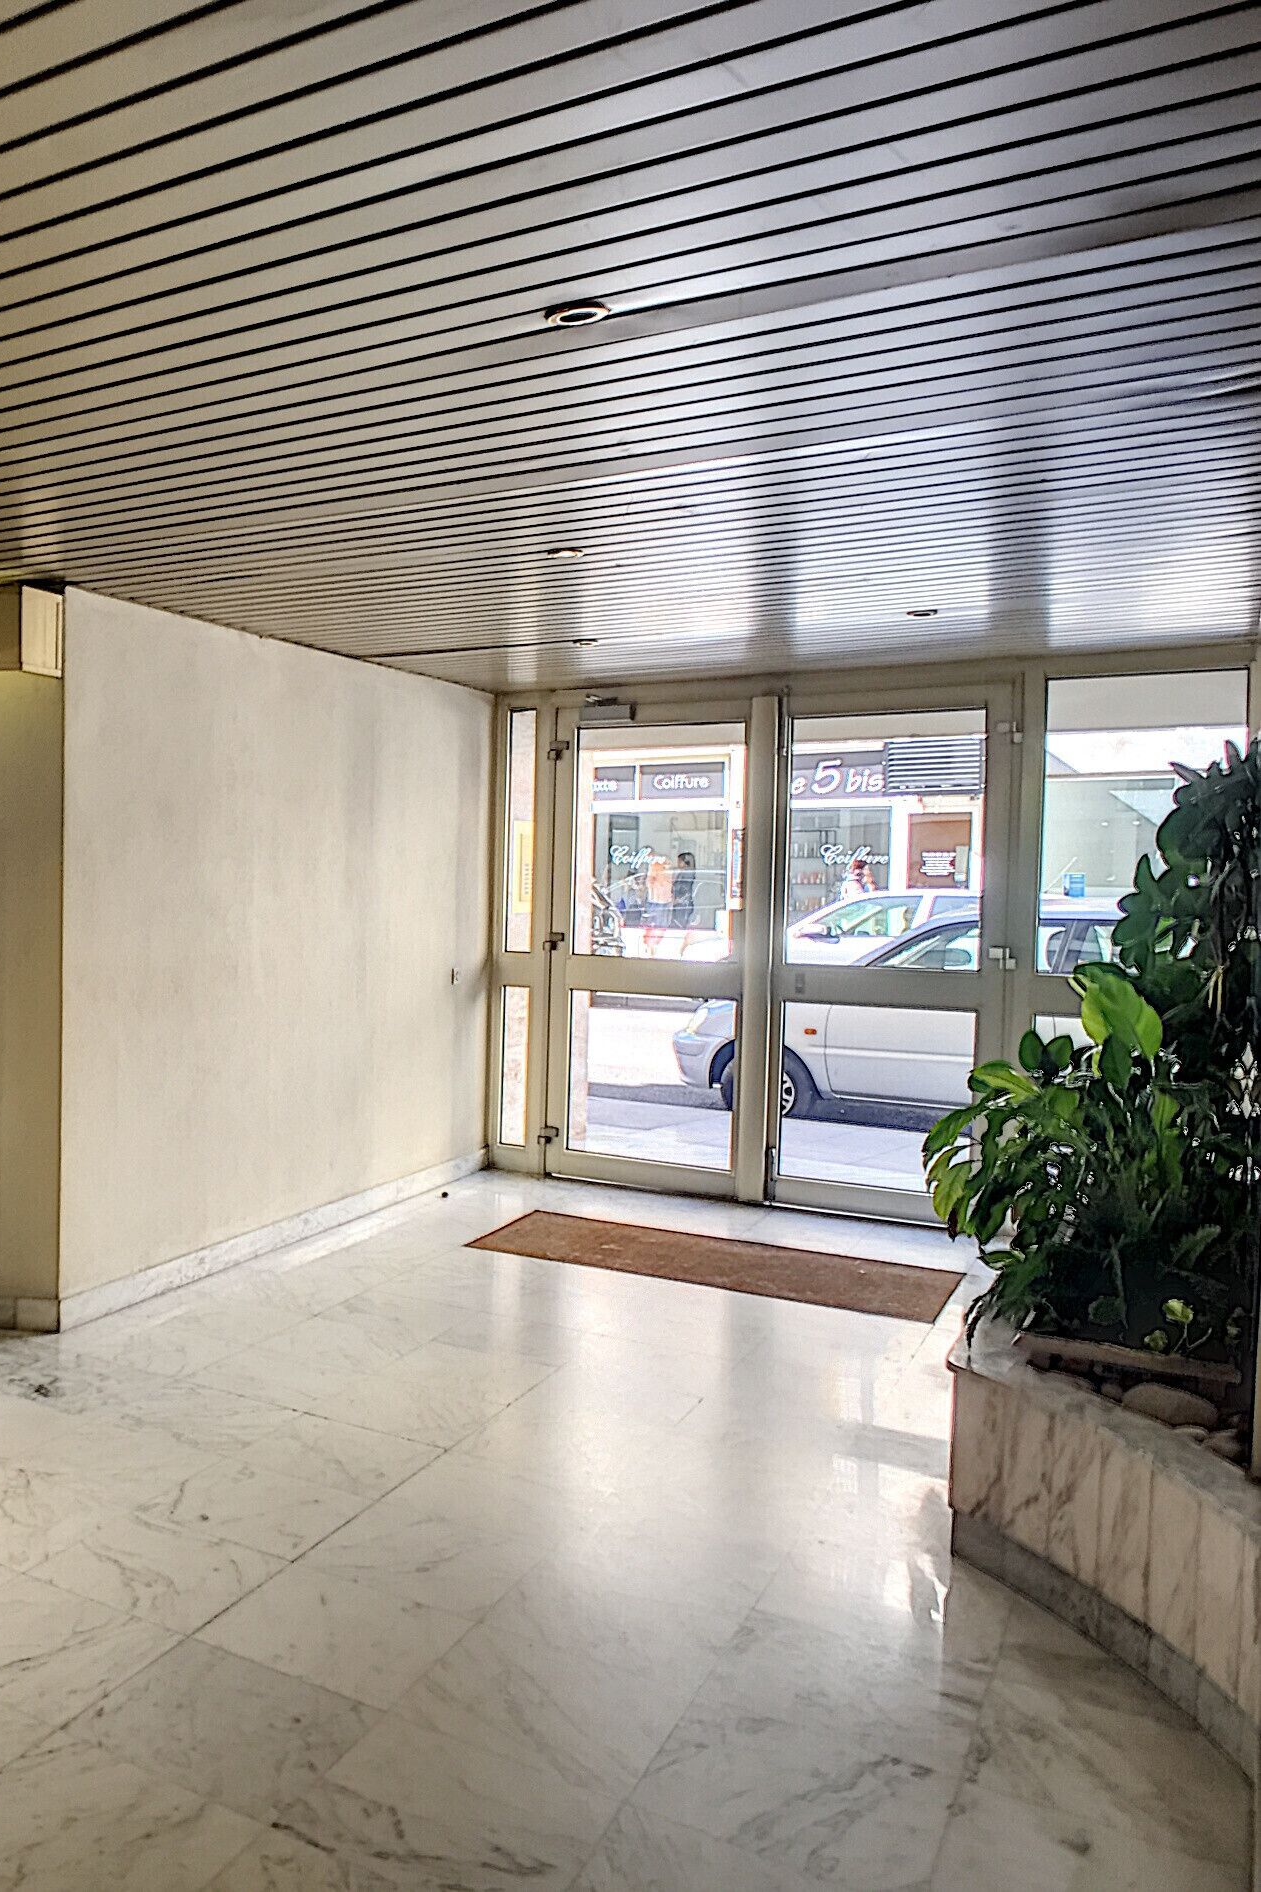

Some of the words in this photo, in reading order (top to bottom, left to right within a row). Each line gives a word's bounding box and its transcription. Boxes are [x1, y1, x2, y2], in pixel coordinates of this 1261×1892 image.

[653, 773, 710, 790] Coiffure
[811, 758, 843, 794] 5
[820, 844, 889, 872] Coiffure
